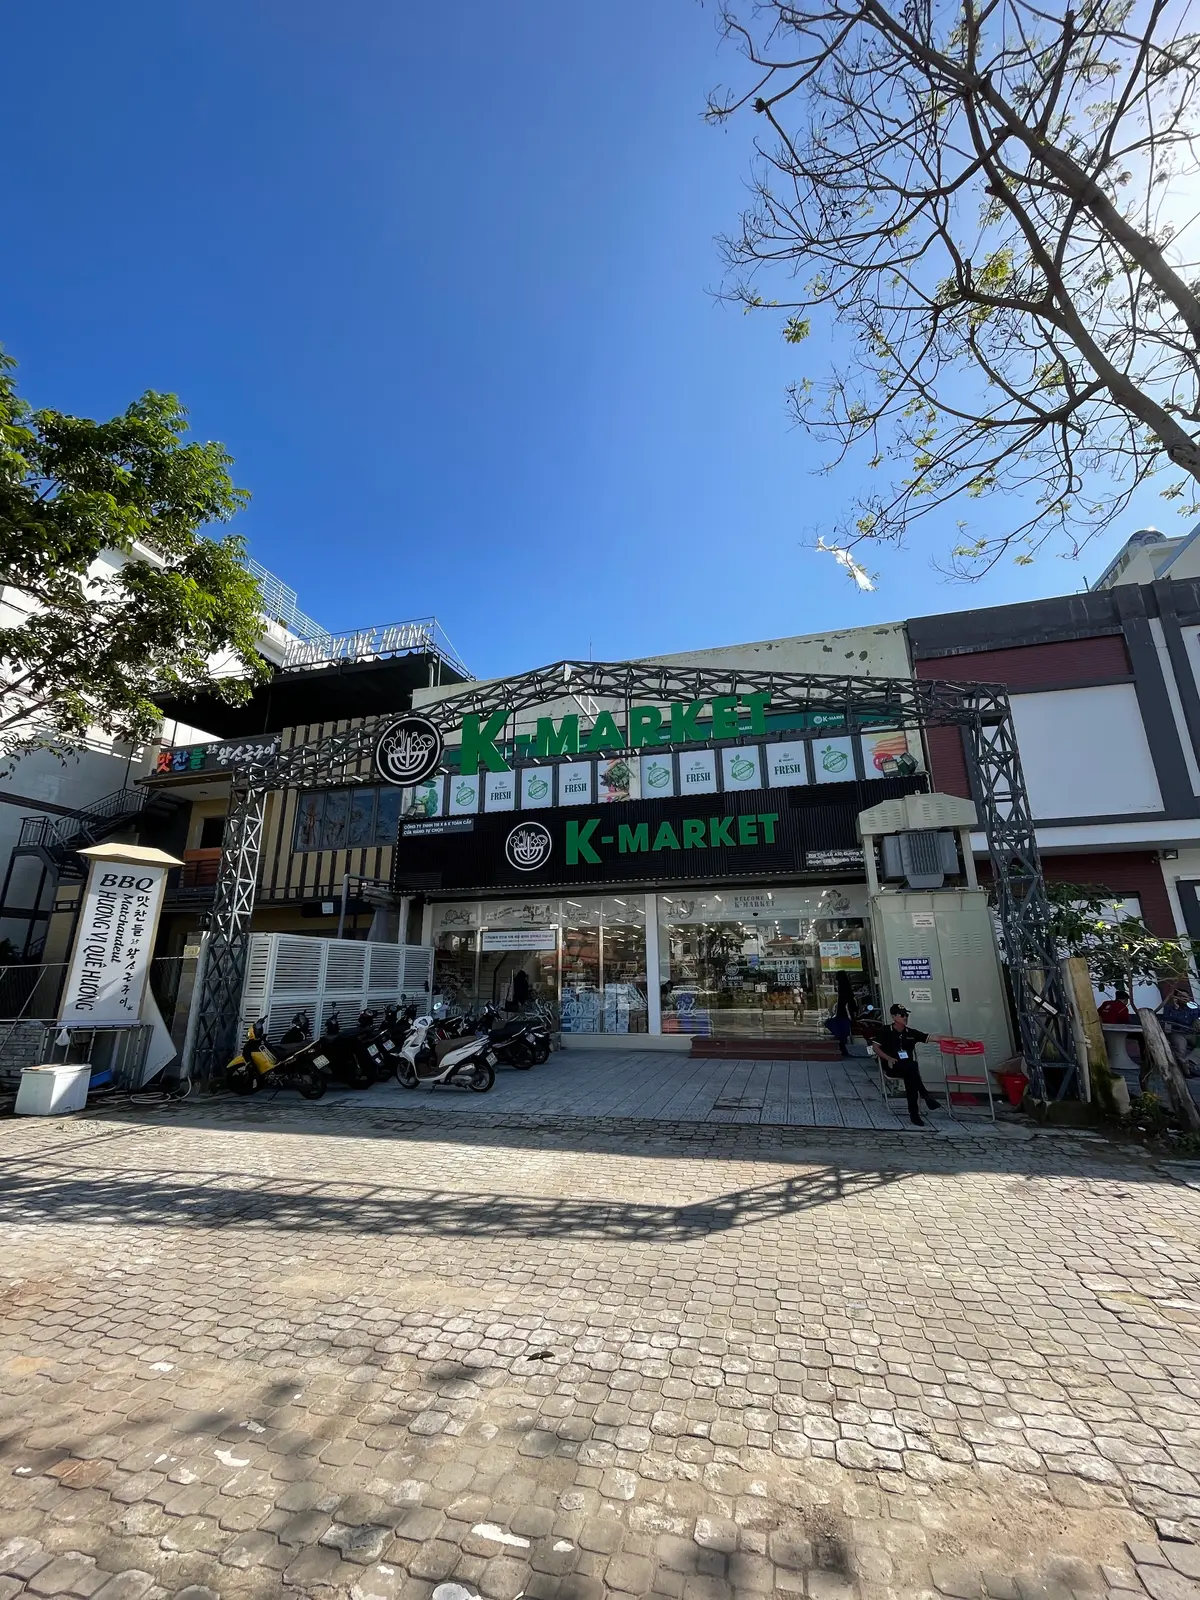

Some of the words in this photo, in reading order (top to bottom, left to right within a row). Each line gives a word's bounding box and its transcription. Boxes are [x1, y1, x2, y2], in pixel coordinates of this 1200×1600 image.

[460, 692, 771, 775] K-MARKET
[157, 747, 205, 773] 맛찬들
[774, 764, 801, 775] FRESH
[686, 771, 711, 783] FRESH
[490, 791, 512, 801] FRESH
[564, 783, 587, 794] FRESH
[565, 812, 779, 865] K-MARKET
[100, 873, 154, 893] BBQ
[92, 889, 117, 930] HƯƠNG
[734, 900, 775, 908] K-MARKET
[131, 894, 150, 937] 맛찬들
[86, 932, 109, 943] VỊ
[111, 893, 134, 963] Matchandeul
[83, 944, 107, 968] QUÊ
[779, 973, 800, 982] CLOSE
[75, 969, 101, 1011] HƯƠNG
